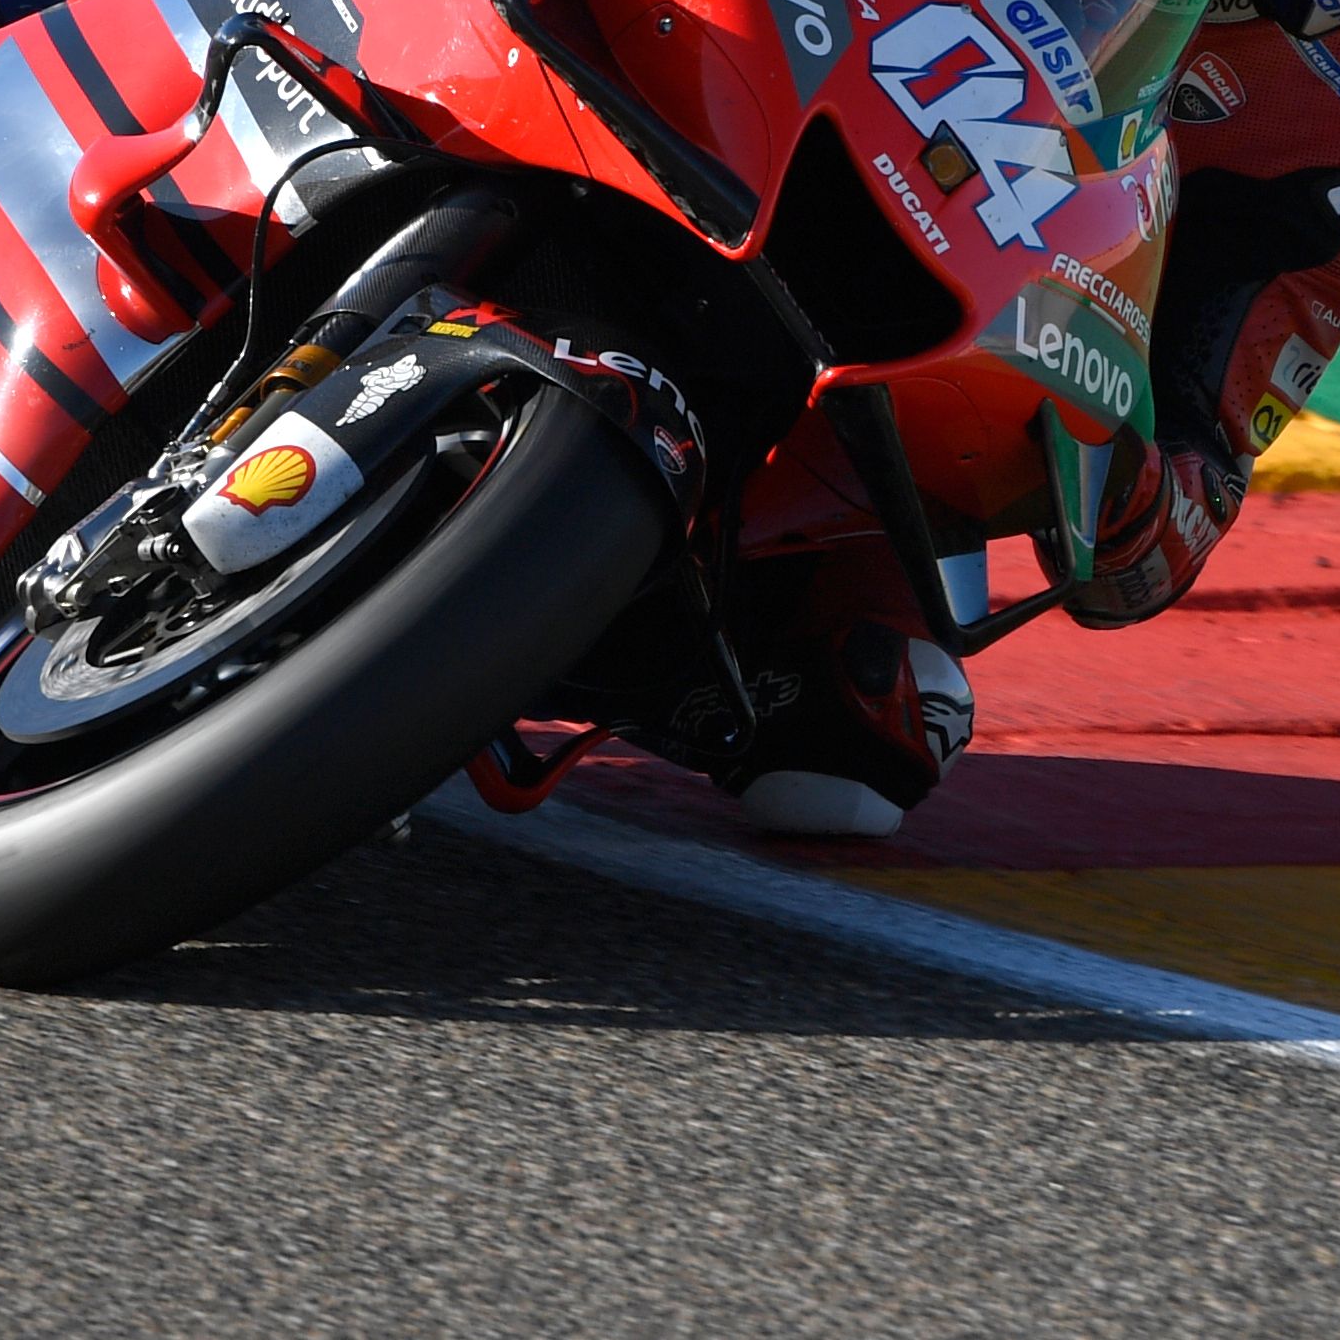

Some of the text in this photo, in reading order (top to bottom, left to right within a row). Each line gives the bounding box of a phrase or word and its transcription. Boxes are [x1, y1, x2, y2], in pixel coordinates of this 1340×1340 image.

[869, 1, 1079, 251] 04
[1200, 60, 1241, 106] DUCATI
[872, 153, 951, 255] DUCATI
[554, 338, 705, 460] Leno
[1015, 296, 1133, 417] Lenovo
